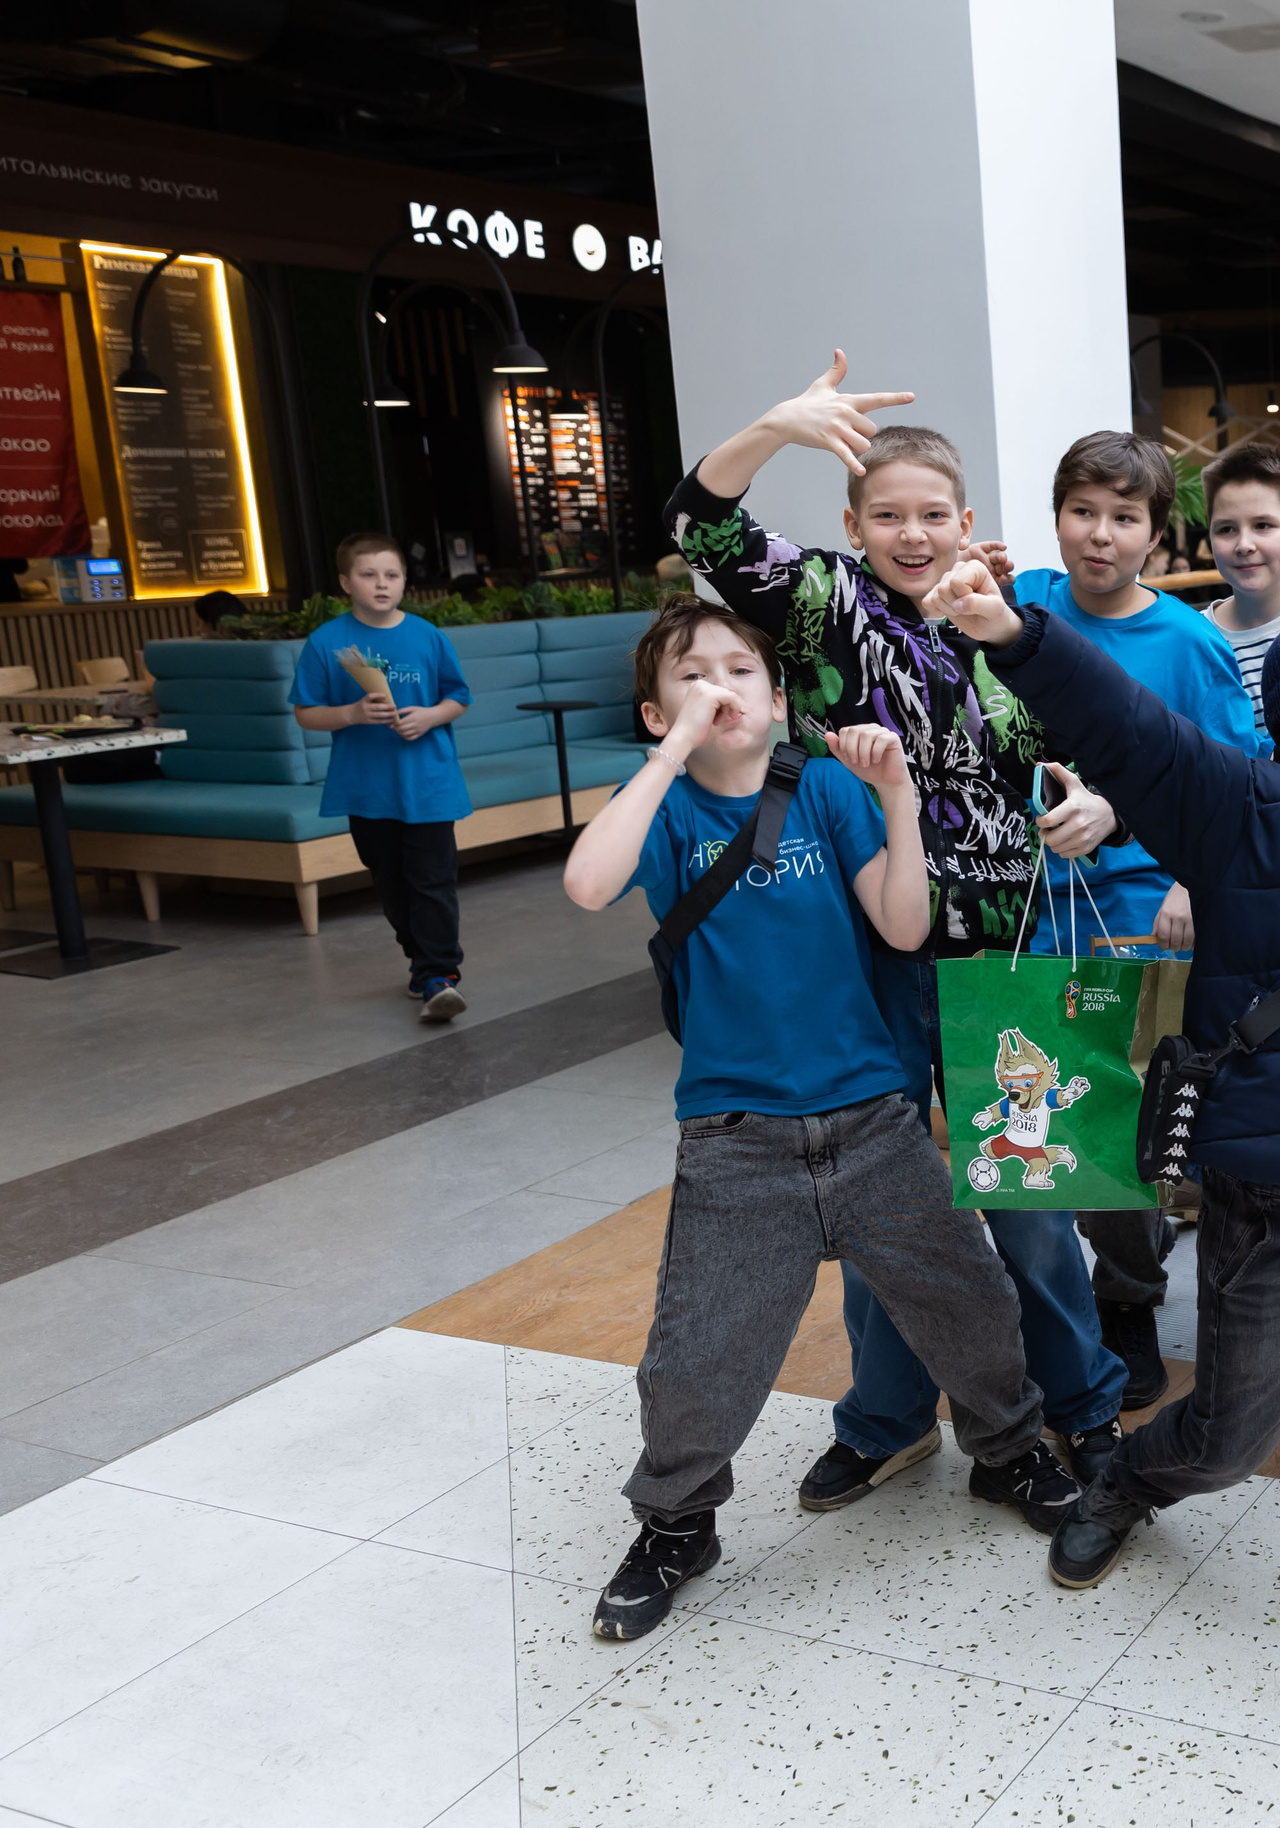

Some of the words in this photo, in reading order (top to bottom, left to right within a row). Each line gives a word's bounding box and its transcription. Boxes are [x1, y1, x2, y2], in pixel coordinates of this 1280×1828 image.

[139, 176, 219, 201] закуски
[409, 201, 546, 259] КОФЕ
[0, 437, 51, 453] акао
[0, 514, 65, 529] околад
[386, 670, 421, 684] РИЯ
[778, 837, 805, 848] детская
[1082, 992, 1121, 1003] RUSSIA
[1082, 1002, 1105, 1011] 2018
[1011, 1119, 1037, 1133] 2018
